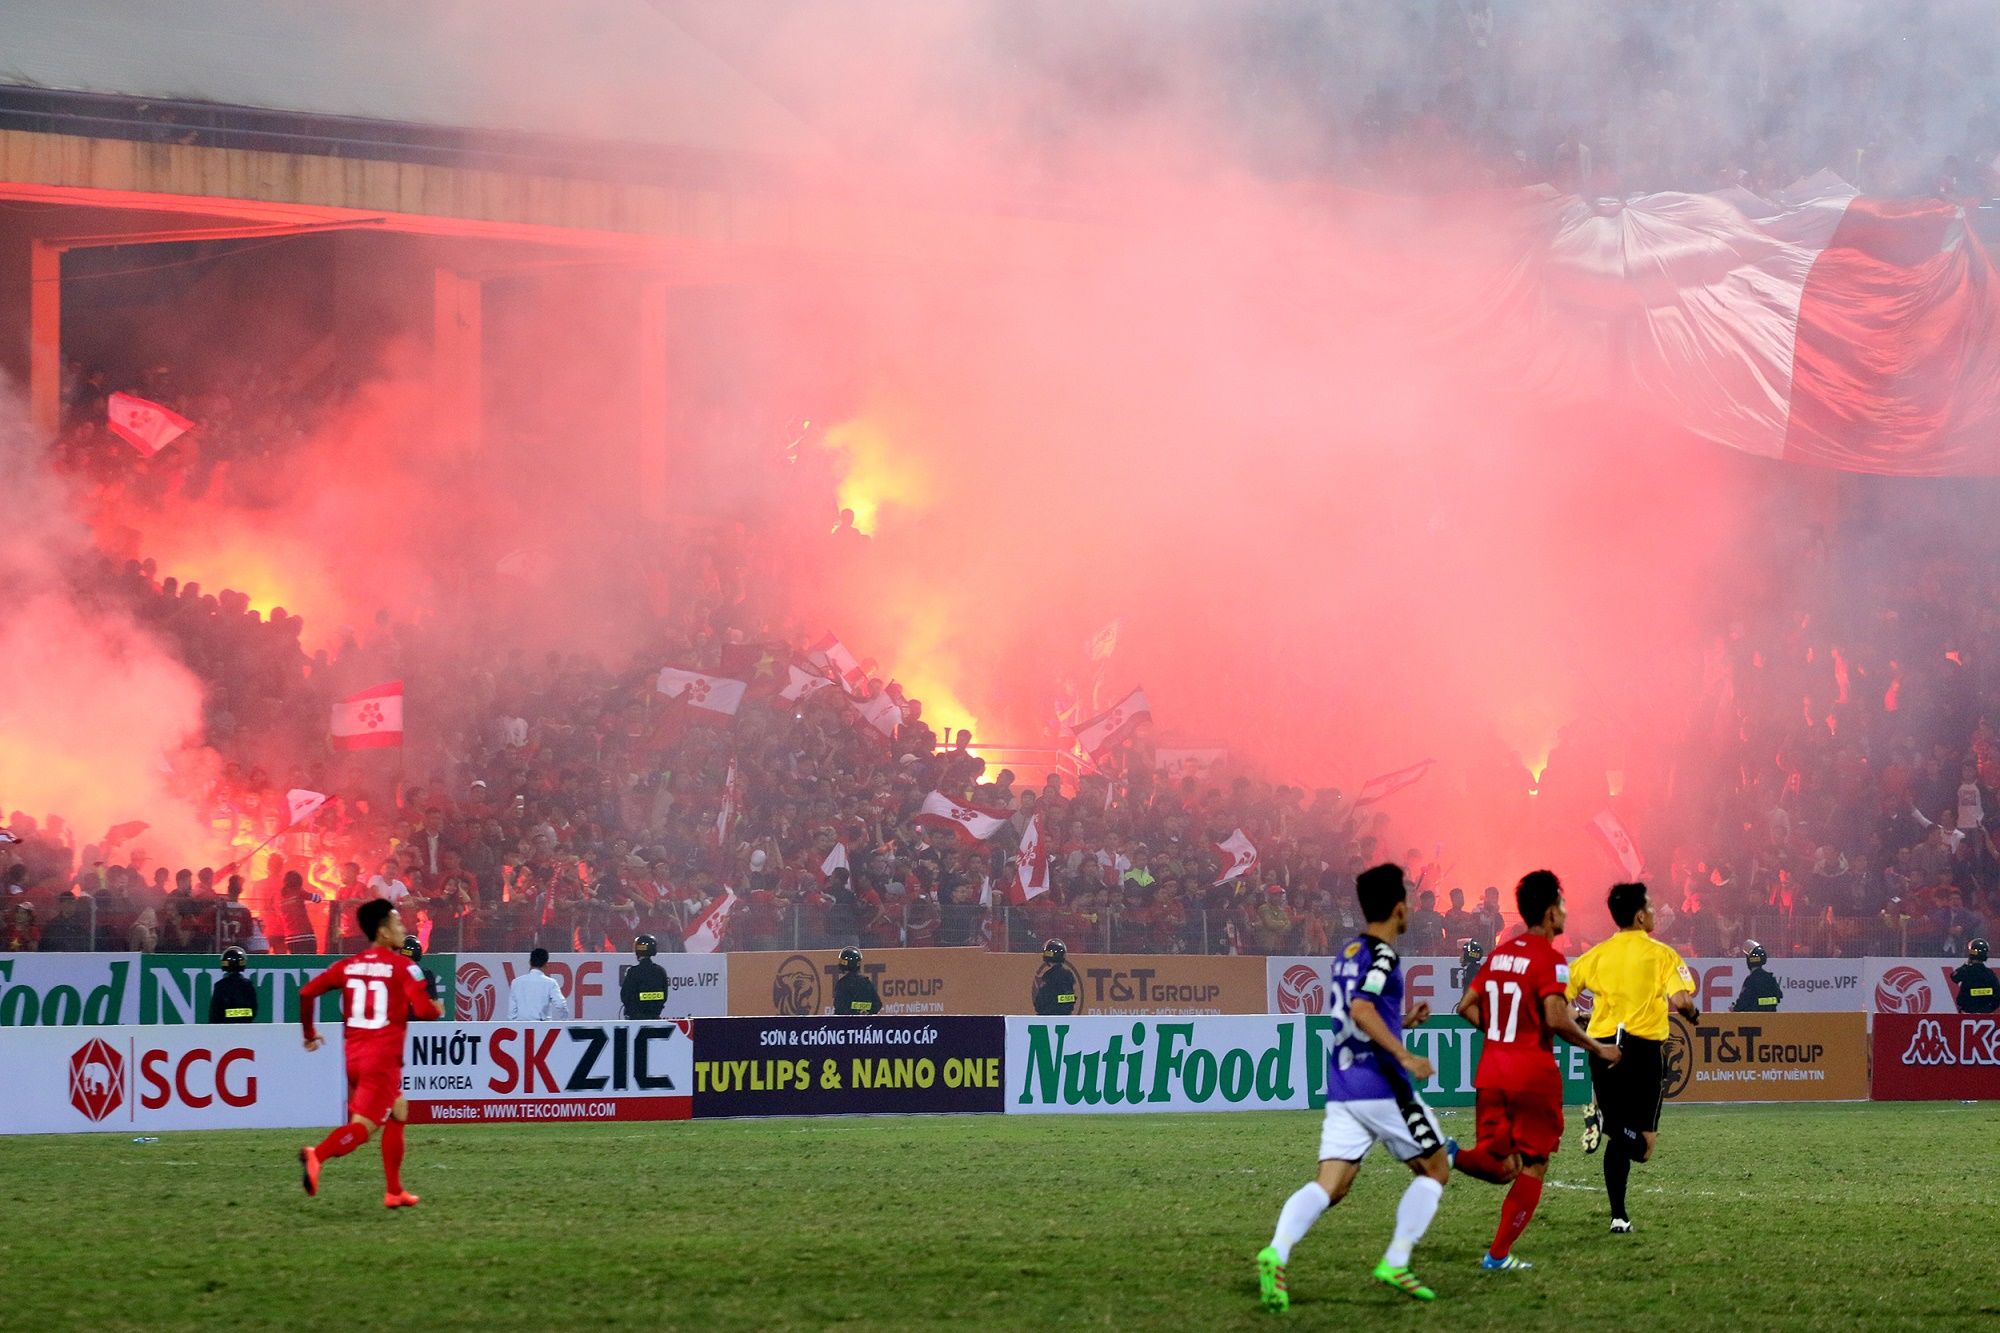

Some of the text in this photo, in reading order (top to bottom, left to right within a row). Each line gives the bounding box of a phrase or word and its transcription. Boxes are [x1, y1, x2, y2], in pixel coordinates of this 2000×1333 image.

[0, 959, 130, 1025] ood
[346, 979, 391, 1029] 11
[883, 979, 943, 997] GROUP
[1152, 985, 1220, 1002] GROUP
[1485, 980, 1522, 1042] 17
[412, 1030, 481, 1066] NHỚT
[760, 1025, 938, 1046] SƠN & CHỐNG THẤM CAO CẤP
[1695, 1027, 1824, 1063] T&T GROUP
[141, 1047, 257, 1109] SCG
[415, 1077, 426, 1090] IN
[430, 1076, 472, 1090] KOREA
[695, 1057, 999, 1092] TUYLIPS & NANO ONE
[1809, 1070, 1825, 1080] TIN
[431, 1103, 616, 1119] Website: WWW.TEKCOMVN.COM
